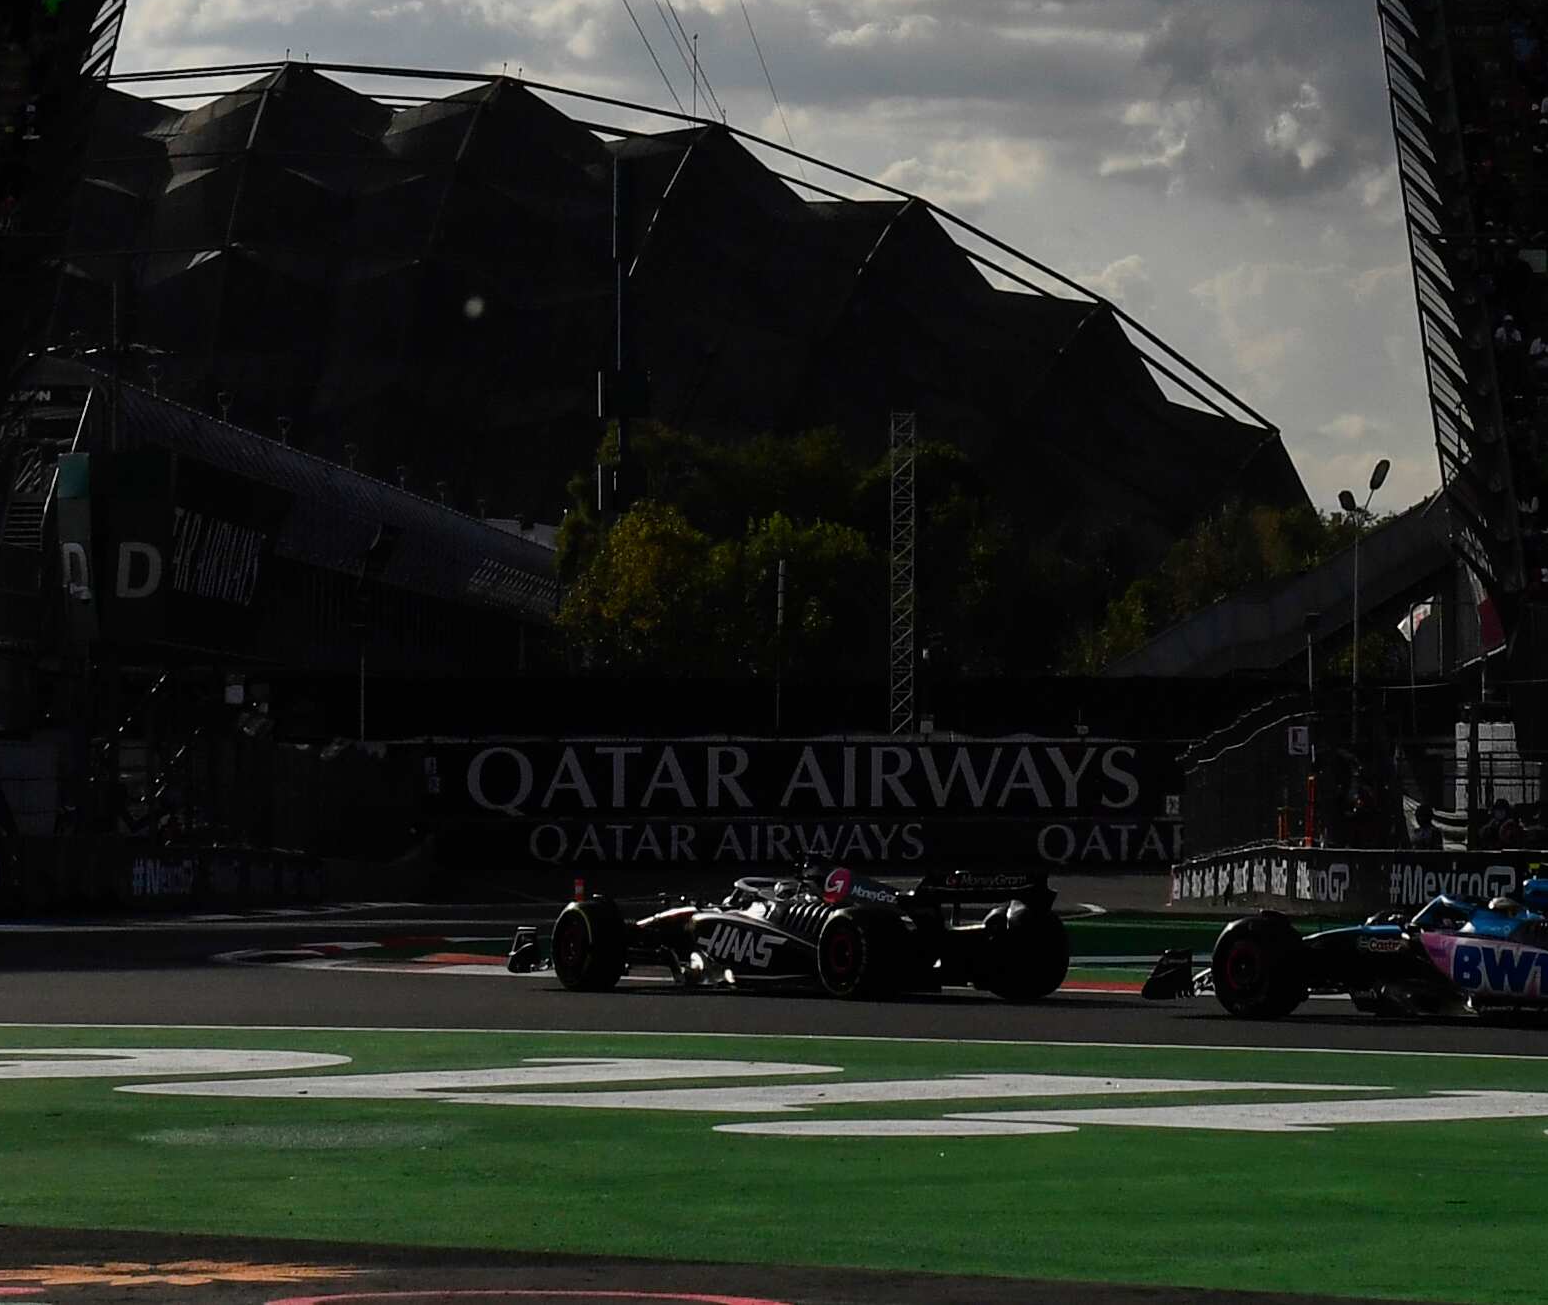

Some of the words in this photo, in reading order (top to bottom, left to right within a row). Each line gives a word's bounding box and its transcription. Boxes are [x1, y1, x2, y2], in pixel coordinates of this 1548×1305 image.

[116, 542, 162, 599] D
[466, 744, 755, 815] QATAR
[780, 744, 1140, 809] AIRWAYS
[528, 823, 698, 864] QATAR
[720, 823, 925, 862] AIRWAYS
[1389, 861, 1517, 905] #MexicoGP
[696, 923, 790, 969] HAAS
[1369, 939, 1412, 952] Castr
